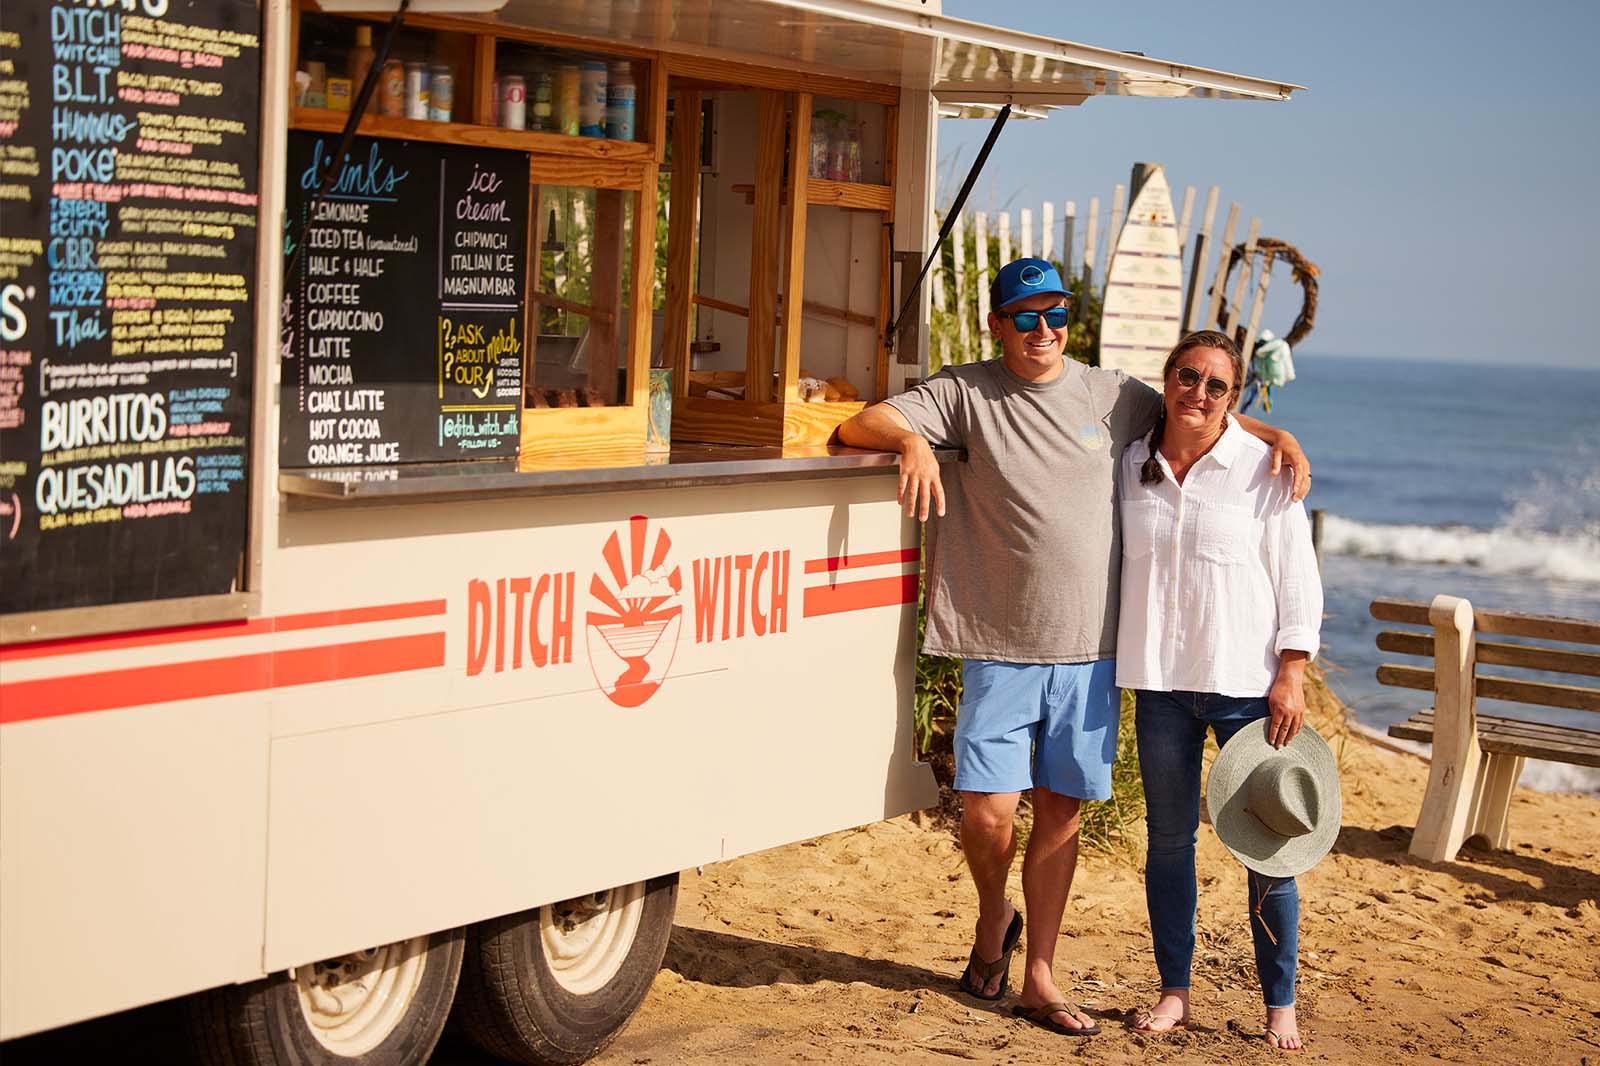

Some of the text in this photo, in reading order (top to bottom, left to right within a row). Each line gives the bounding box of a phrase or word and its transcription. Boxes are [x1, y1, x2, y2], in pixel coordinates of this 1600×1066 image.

[51, 6, 121, 45] DITCH
[301, 139, 409, 194] dinks
[467, 163, 503, 192] ice
[310, 201, 369, 223] LEMONADE
[309, 228, 341, 249] ICED
[342, 229, 365, 250] TEA
[455, 231, 508, 249] CHIPWICH
[308, 255, 340, 276] HALF
[353, 257, 385, 277] HALF
[450, 254, 515, 272] ITALIAN ICE
[49, 285, 104, 306] MOZZ
[307, 283, 361, 305] COFFEE
[443, 276, 516, 297] MAGNUM BAR
[48, 309, 108, 349] Thai
[307, 309, 384, 333] CAPPUCCINO
[456, 323, 486, 346] ASK
[308, 337, 351, 359] LATTE
[455, 348, 486, 365] ABOUT
[308, 364, 354, 386] MOCHA
[454, 365, 484, 386] OUR
[307, 390, 385, 413] CHAI LATTE
[40, 393, 167, 452] BURRITOS
[309, 417, 381, 441] HOT COCOA
[307, 442, 400, 465] ORANGE JUICE
[35, 455, 197, 515] QUESADILLAS
[466, 549, 791, 677] DITCH WITCH
